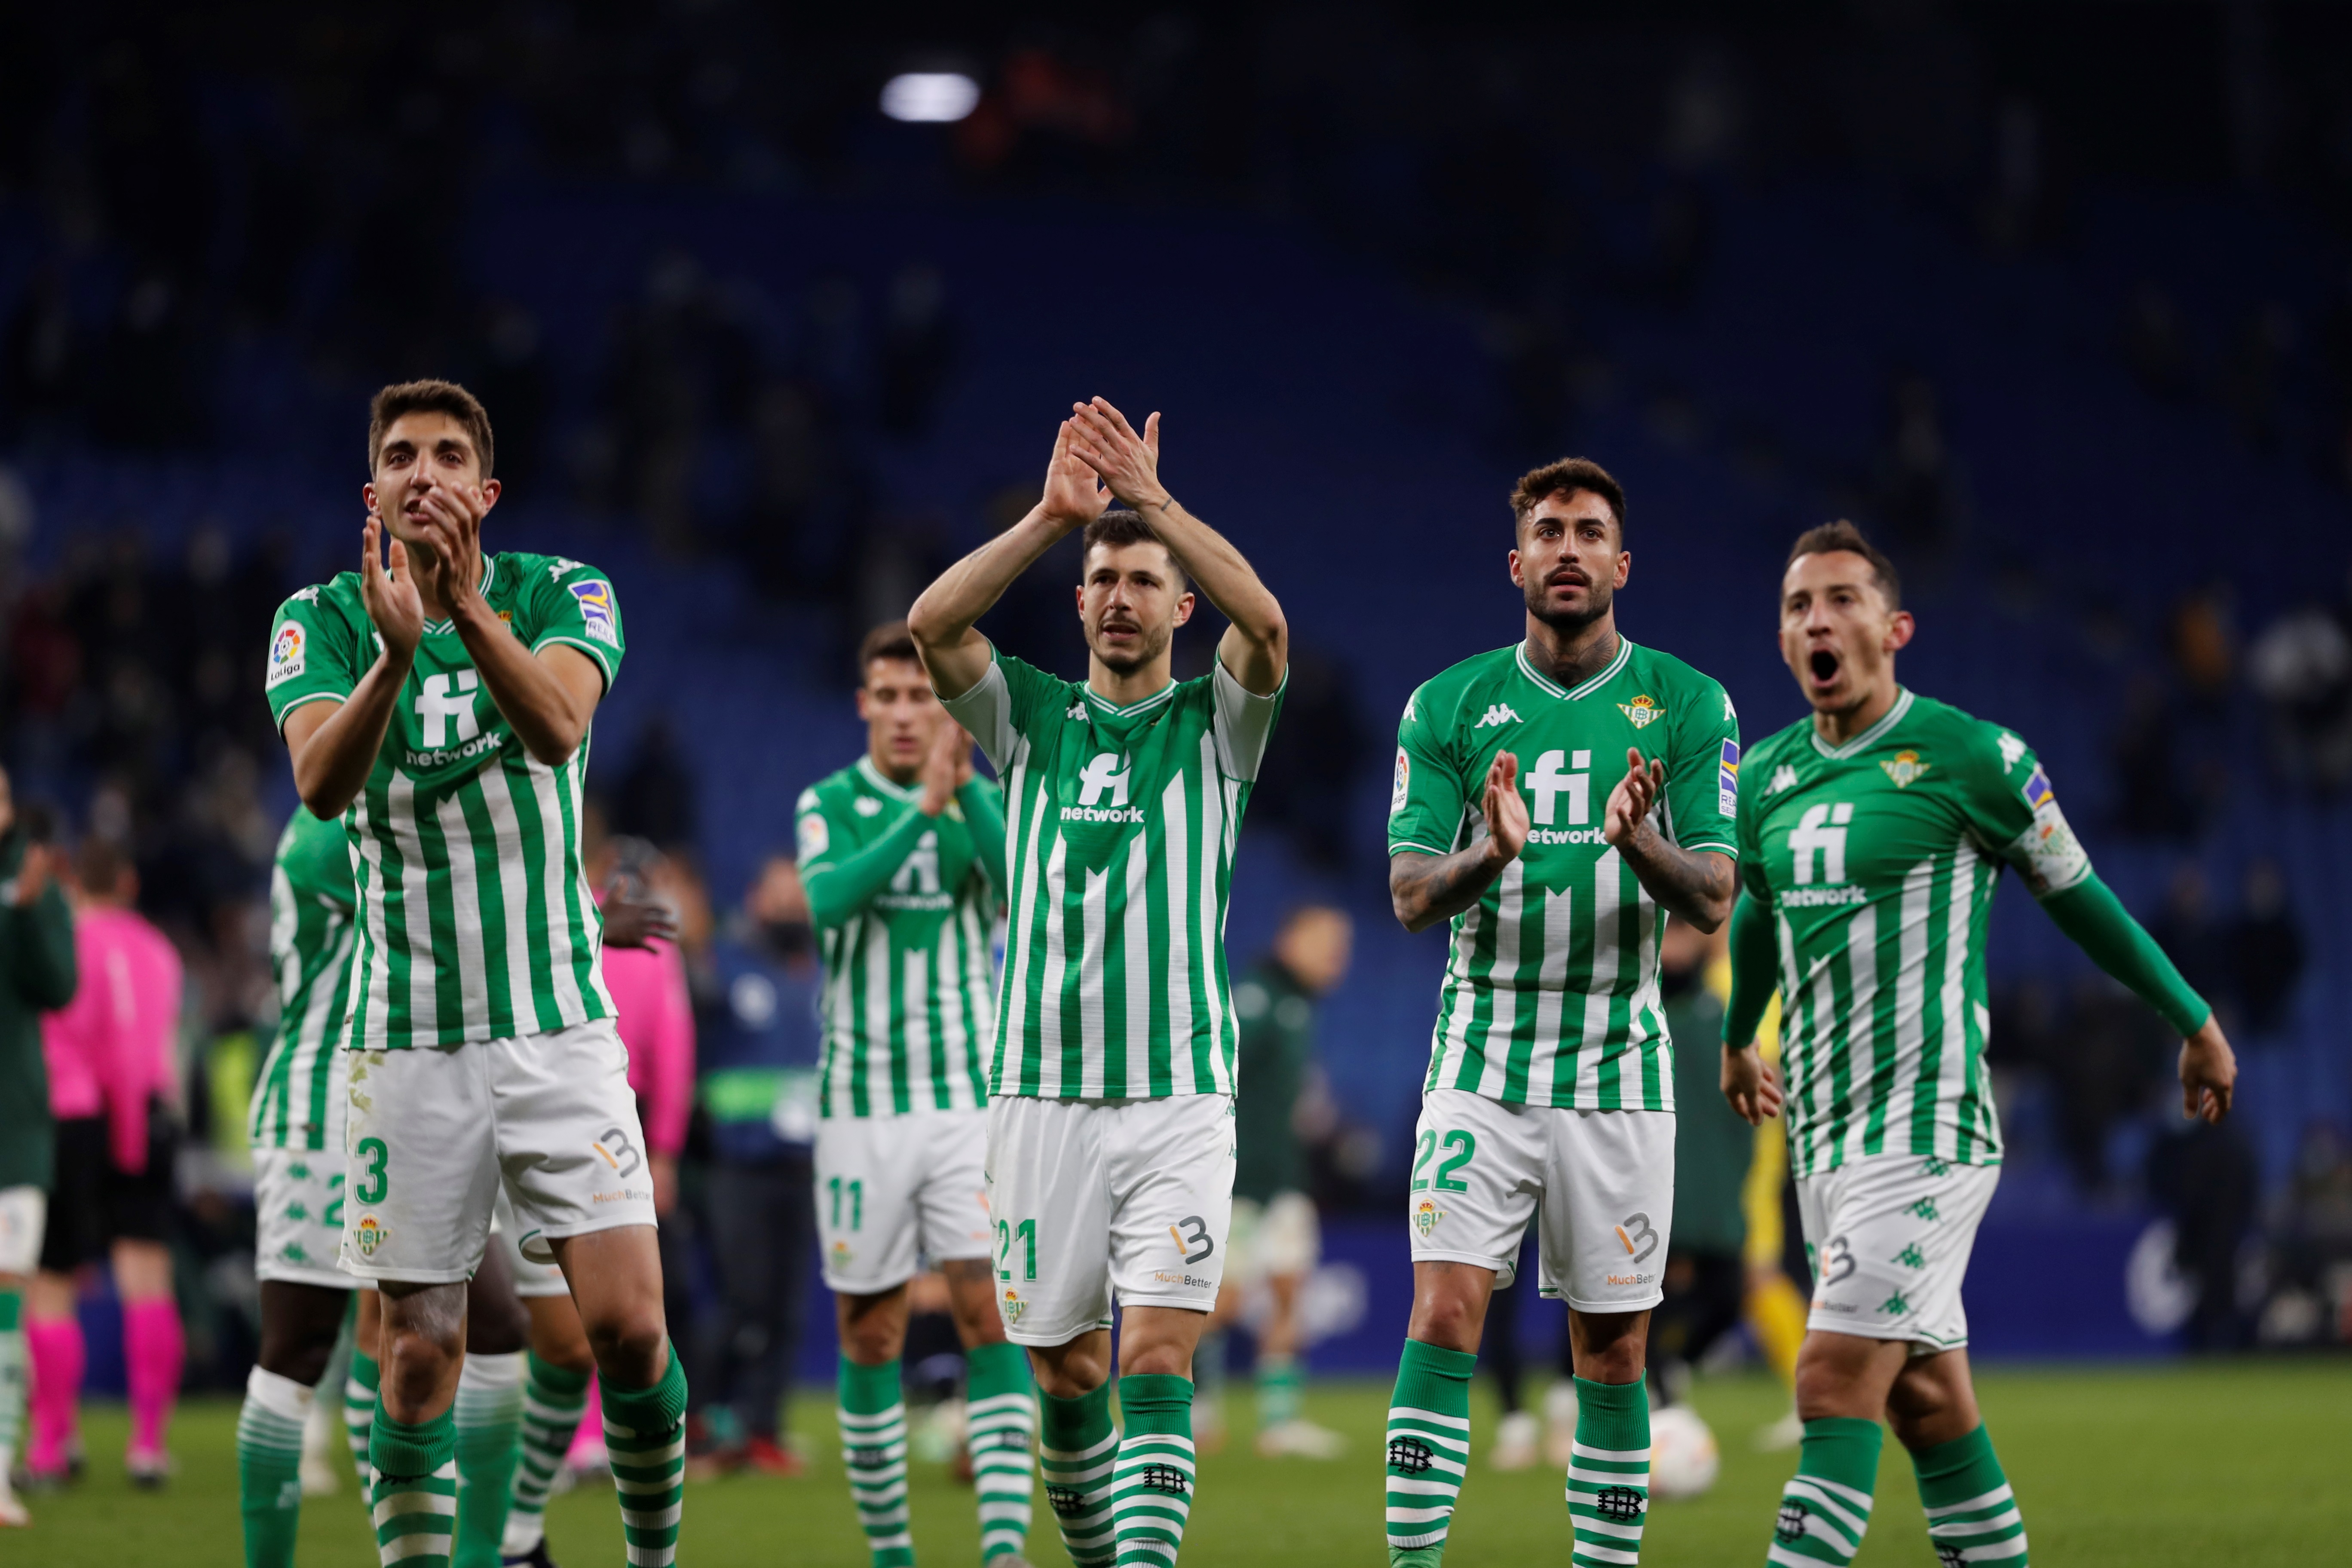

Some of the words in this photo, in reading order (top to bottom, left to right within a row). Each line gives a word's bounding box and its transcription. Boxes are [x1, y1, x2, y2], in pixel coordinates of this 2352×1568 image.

[271, 663, 300, 681] LaLiga
[414, 669, 480, 748] fi
[406, 732, 502, 766] network
[1060, 806, 1145, 823] network
[1525, 749, 1591, 825] fi
[1524, 827, 1608, 845] etwork
[1788, 802, 1854, 885] fi
[1780, 885, 1868, 907] network
[355, 1137, 388, 1204] 3
[1410, 1129, 1476, 1194] 22
[827, 1175, 864, 1231] 11
[998, 1219, 1037, 1282] 21
[1155, 1271, 1212, 1289] MuchBetter
